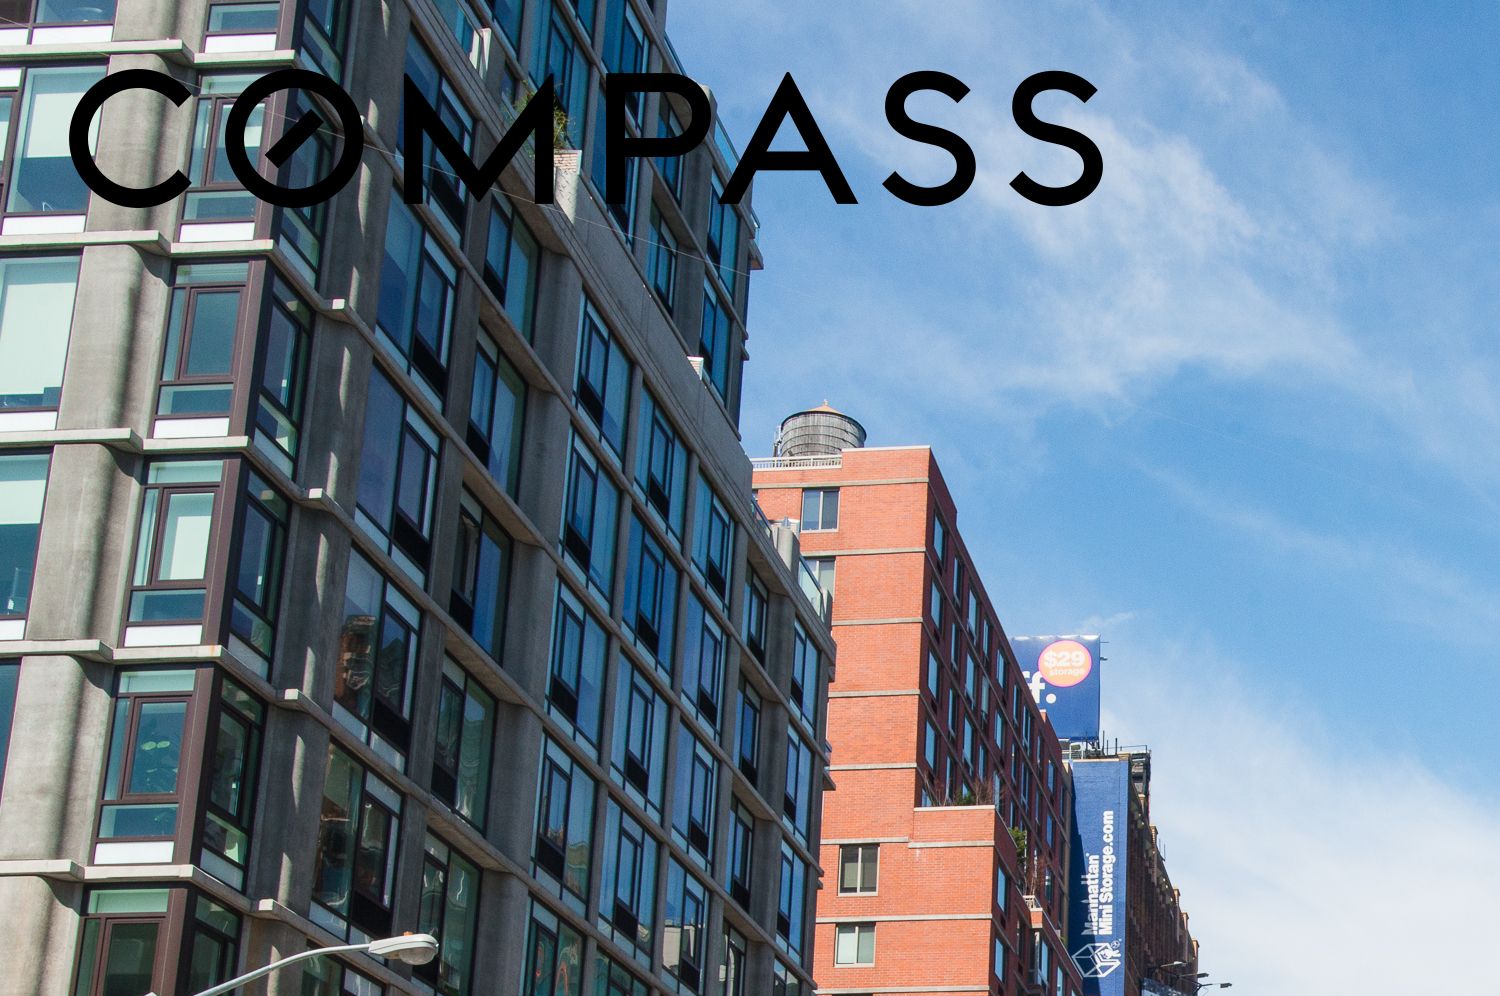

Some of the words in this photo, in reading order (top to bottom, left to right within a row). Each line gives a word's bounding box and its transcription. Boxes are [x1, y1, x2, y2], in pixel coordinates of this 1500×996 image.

[1044, 650, 1085, 668] $29
[1049, 668, 1084, 678] storage
[1099, 810, 1116, 903] Storage.com
[1081, 854, 1100, 936] Manhattan
[1099, 904, 1112, 936] Mini
